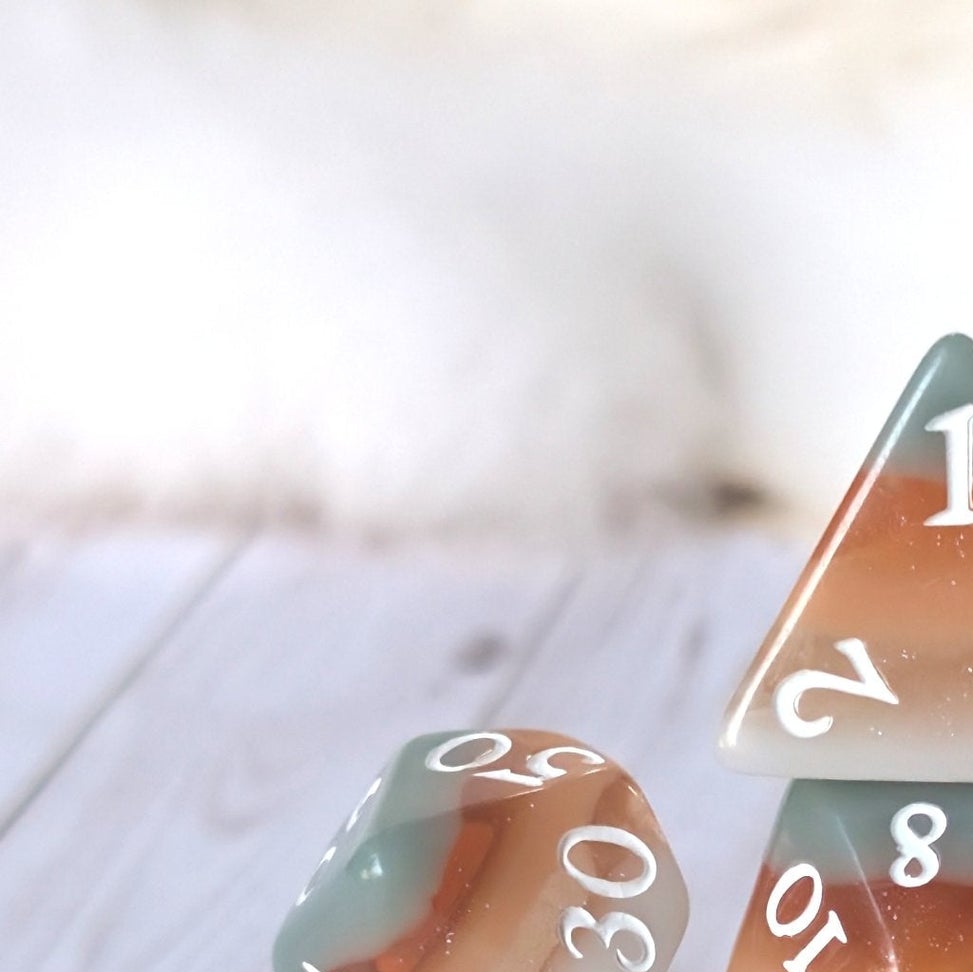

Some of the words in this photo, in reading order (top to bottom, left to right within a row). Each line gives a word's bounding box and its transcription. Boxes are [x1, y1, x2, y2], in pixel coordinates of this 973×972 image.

[774, 636, 899, 739] 2
[425, 732, 606, 787] 50
[889, 802, 948, 888] 8
